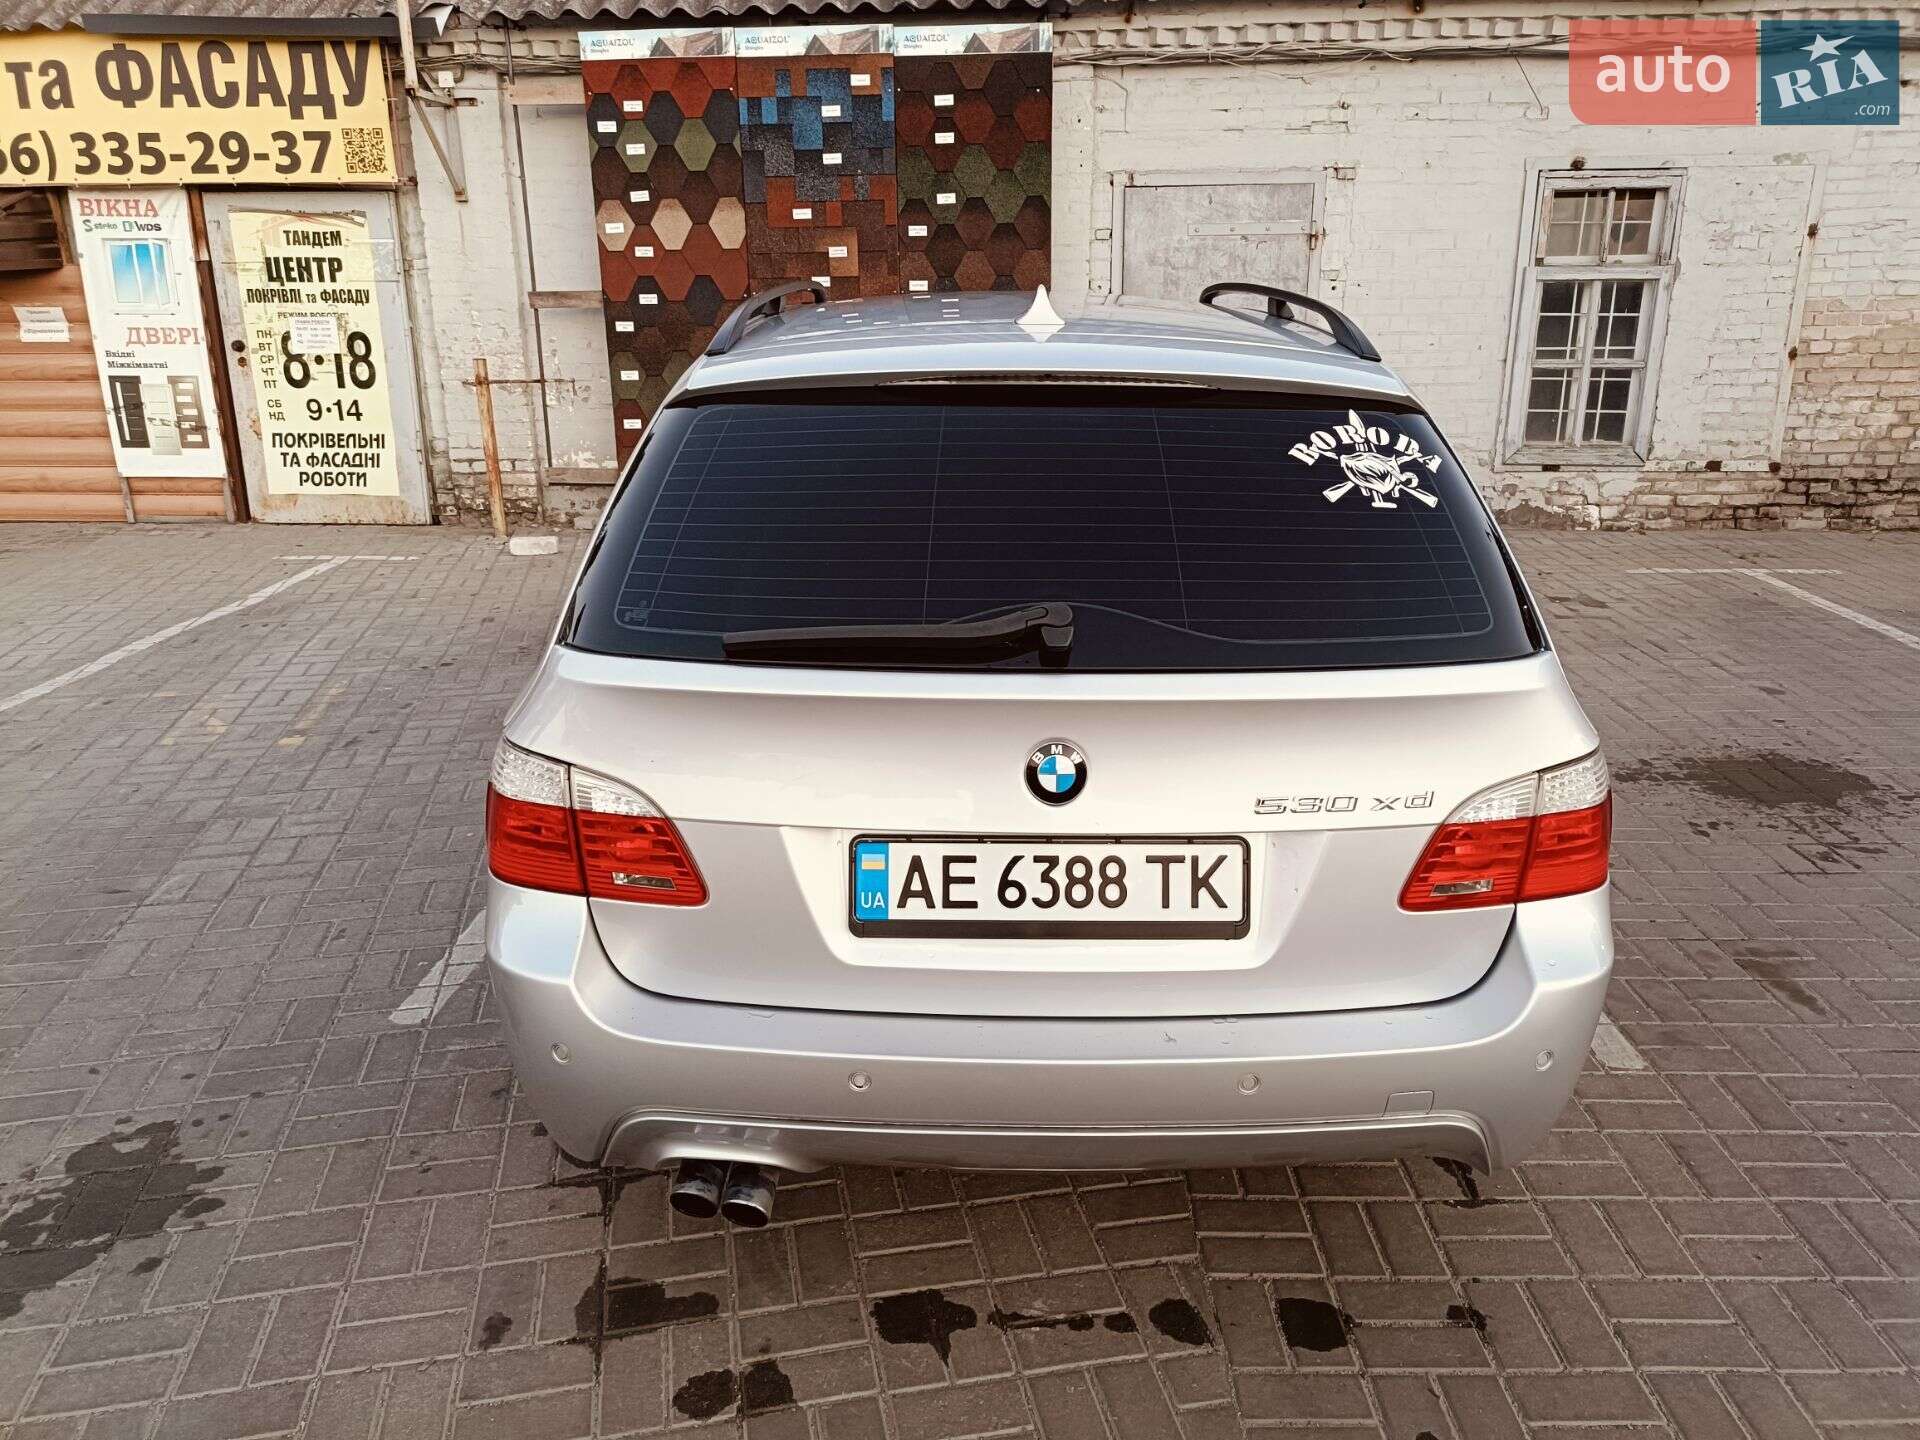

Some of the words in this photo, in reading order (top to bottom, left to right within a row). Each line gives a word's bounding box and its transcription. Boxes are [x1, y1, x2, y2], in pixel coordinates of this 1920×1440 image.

[5, 60, 75, 110] та
[95, 40, 371, 120] ФАСАДУ
[70, 131, 331, 176] 335-29-37
[78, 198, 159, 217] ВІКНА
[283, 230, 342, 249] ТАНДЕМ
[265, 257, 342, 286] ЦЕНТР
[246, 289, 301, 304] ПОКРІВЛІ
[305, 294, 316, 303] та
[320, 289, 369, 306] ФАСАДУ
[126, 327, 200, 347] ДВЕРІ
[256, 330, 272, 338] ПН
[259, 342, 272, 351] ВТ
[260, 355, 274, 364] СР
[262, 368, 275, 376] ЧТ
[264, 380, 277, 389] ПТ
[267, 400, 282, 408] СБ
[269, 412, 285, 421] НД
[272, 433, 385, 449] ПОКРІВЕЛЬНІ
[281, 453, 300, 467] ТА
[306, 453, 380, 468] ФАСАДНІ
[300, 472, 367, 487] РОБОТИ
[1031, 744, 1083, 765] BMW
[1254, 797, 1359, 815] 530
[1370, 791, 1434, 811] xd
[897, 855, 979, 909] AE
[997, 855, 1128, 909] 6388
[1145, 855, 1228, 909] TK
[861, 892, 885, 908] UA
